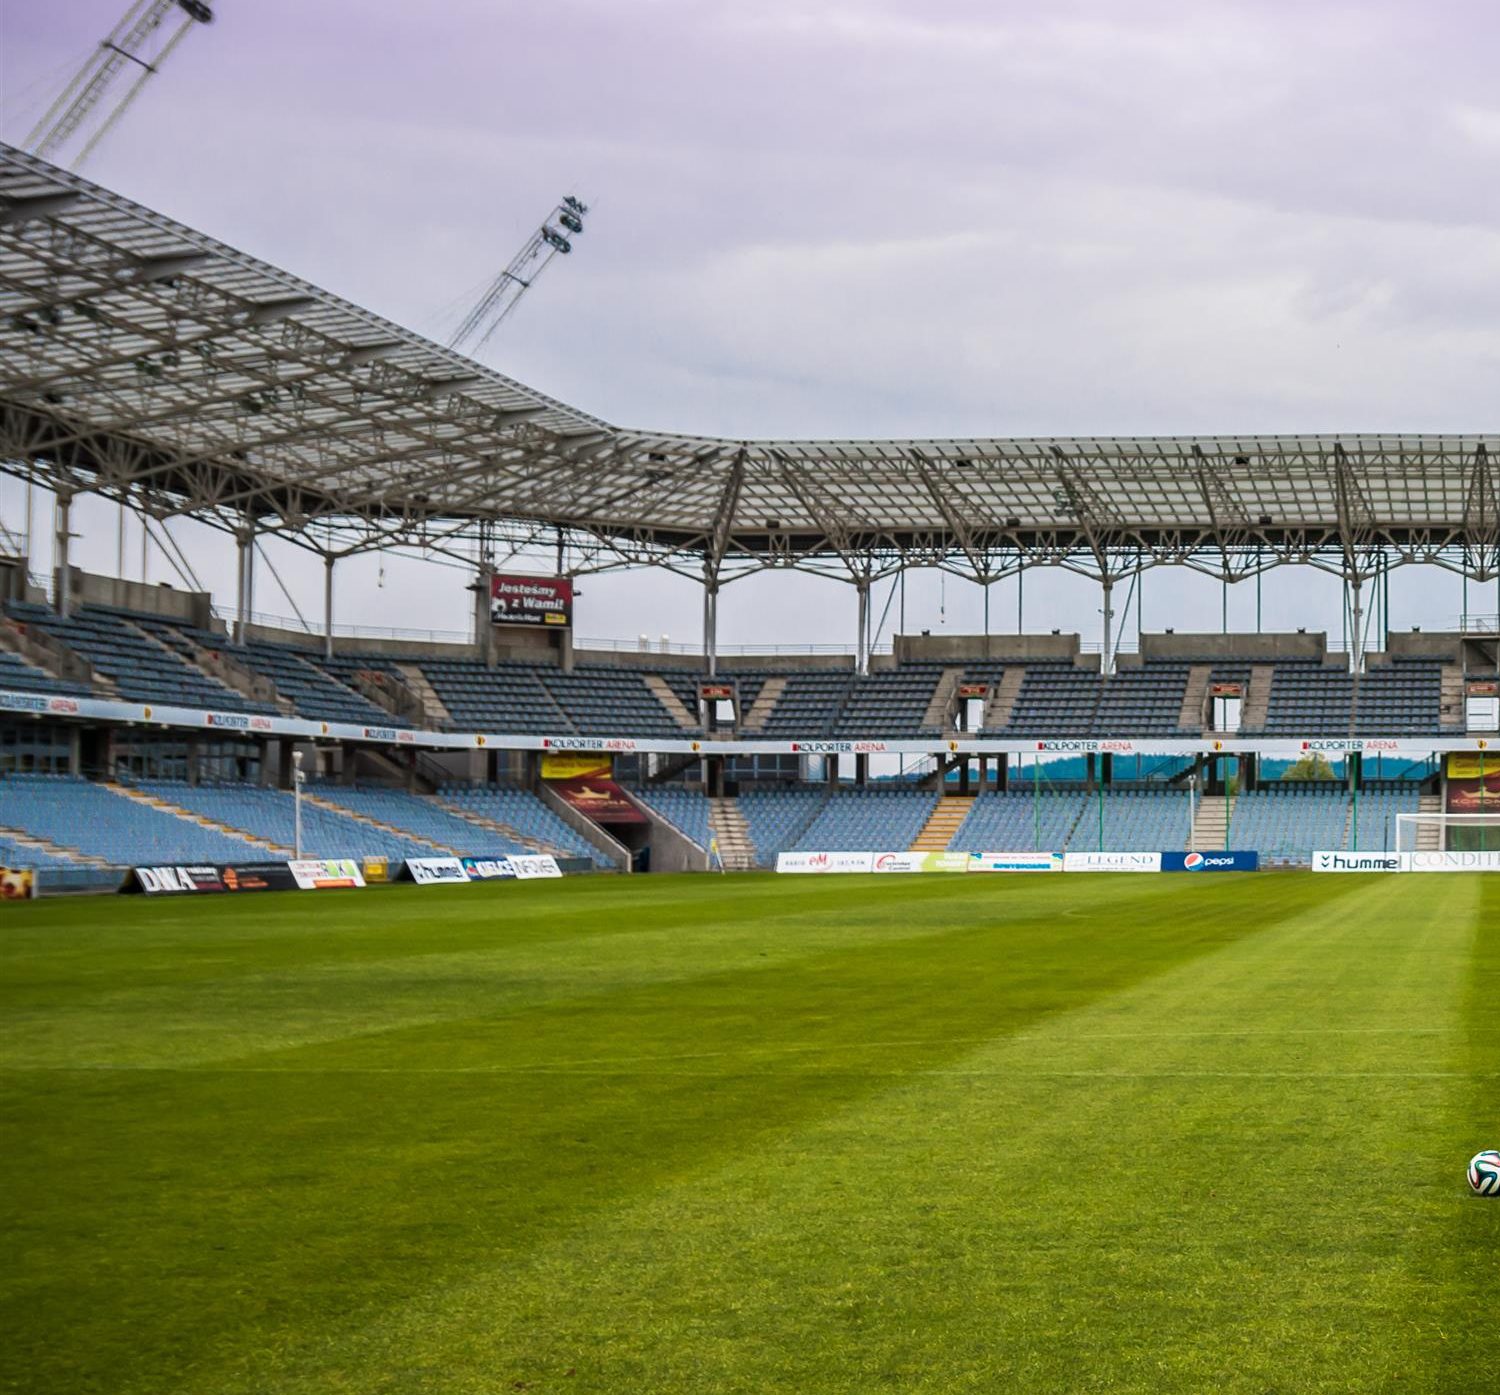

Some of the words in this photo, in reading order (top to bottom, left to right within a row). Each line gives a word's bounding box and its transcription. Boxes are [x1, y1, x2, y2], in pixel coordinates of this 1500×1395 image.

[523, 597, 564, 609] Wami!
[548, 740, 602, 748] KOLPORTER
[606, 741, 636, 749] ARENA
[798, 743, 851, 751] KOLPORTER
[1044, 742, 1098, 750] KOLPORTER
[1101, 742, 1132, 750] ARENA
[1309, 741, 1364, 749] KOLPORTER
[1366, 741, 1398, 749] ARENA
[1088, 855, 1153, 864] LEGEND
[1204, 857, 1234, 866] pepsi
